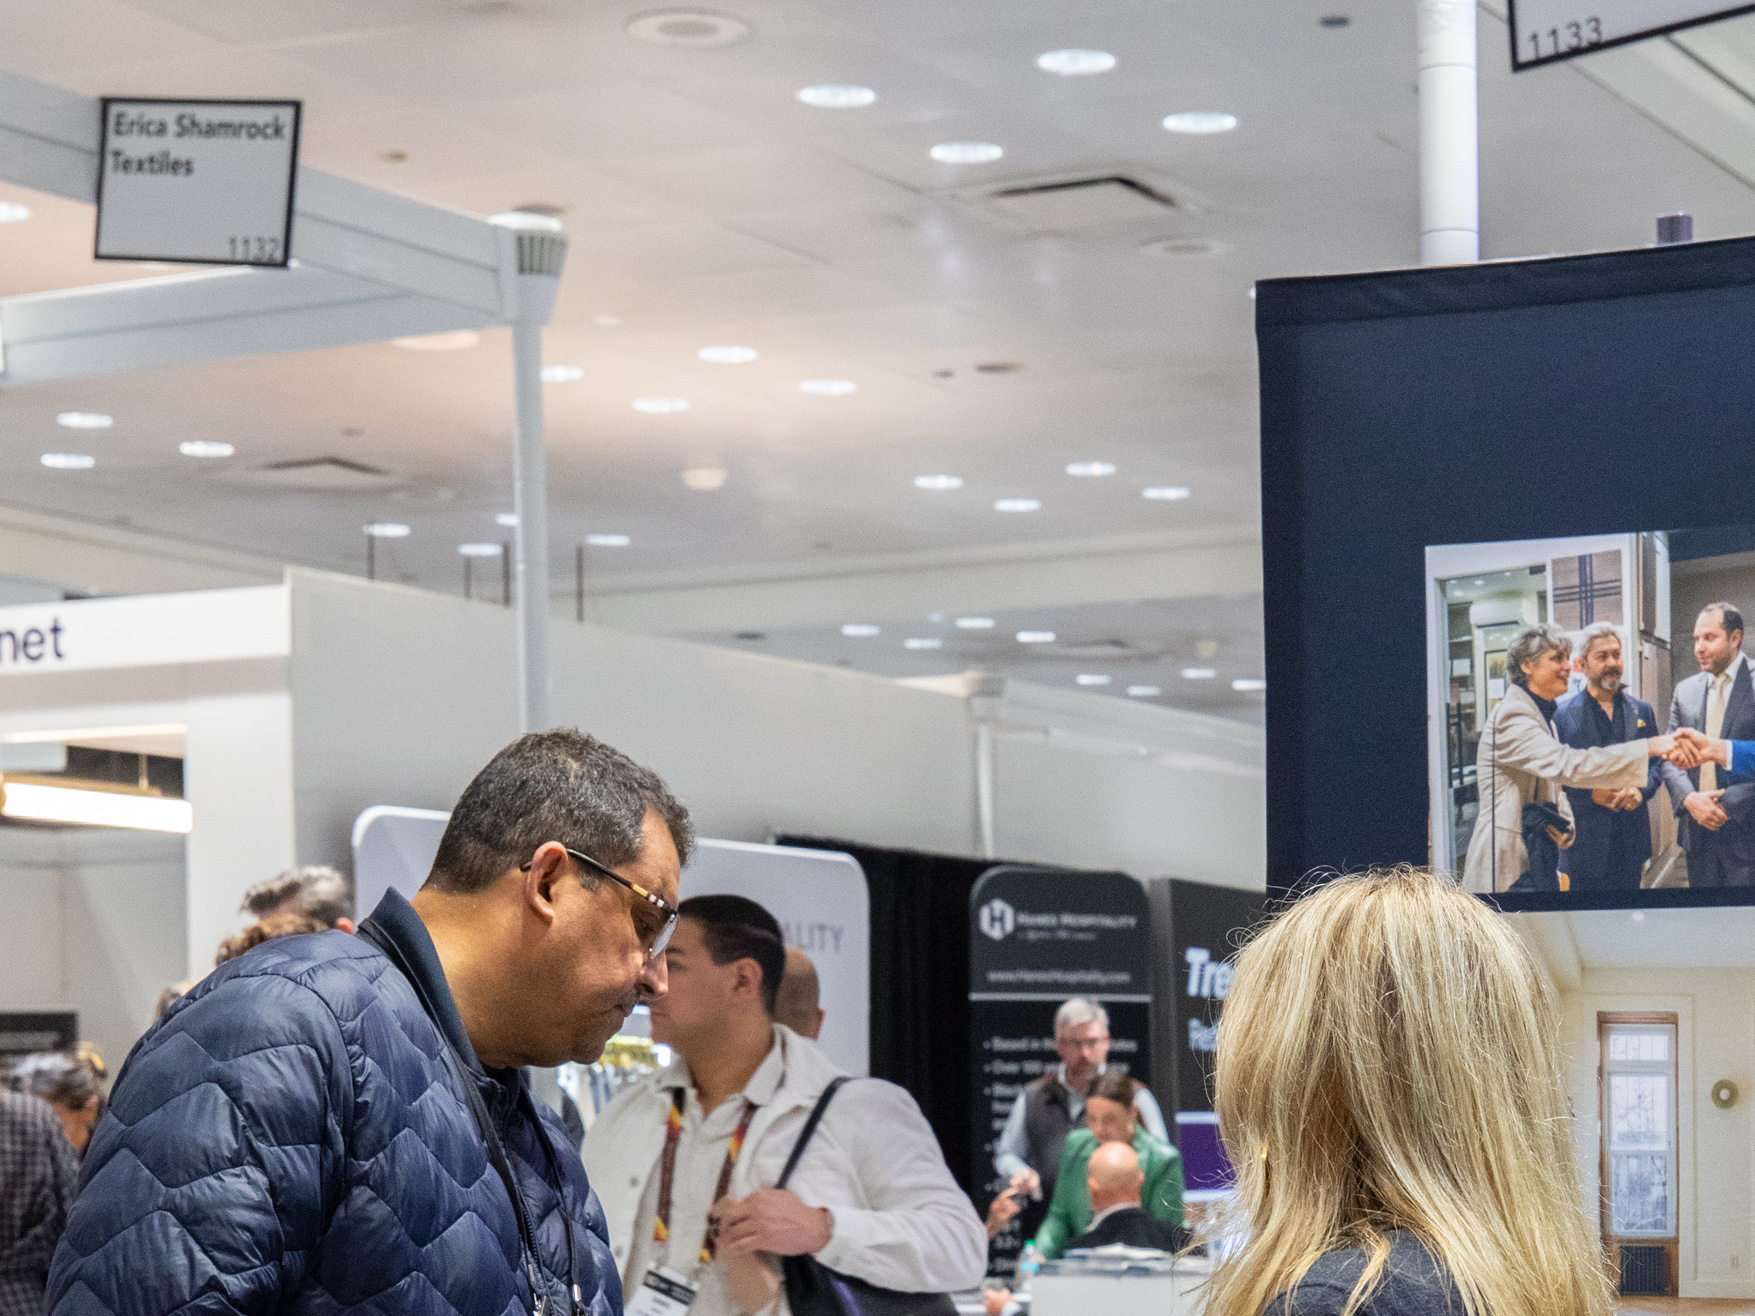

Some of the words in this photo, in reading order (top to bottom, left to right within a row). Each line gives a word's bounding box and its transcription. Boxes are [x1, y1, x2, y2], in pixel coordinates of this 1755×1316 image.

[1528, 16, 1602, 58] 1133
[112, 112, 168, 139] Erica
[173, 112, 286, 141] Shamrock
[110, 150, 194, 176] Textiles
[227, 235, 280, 262] 1132
[0, 617, 65, 662] net
